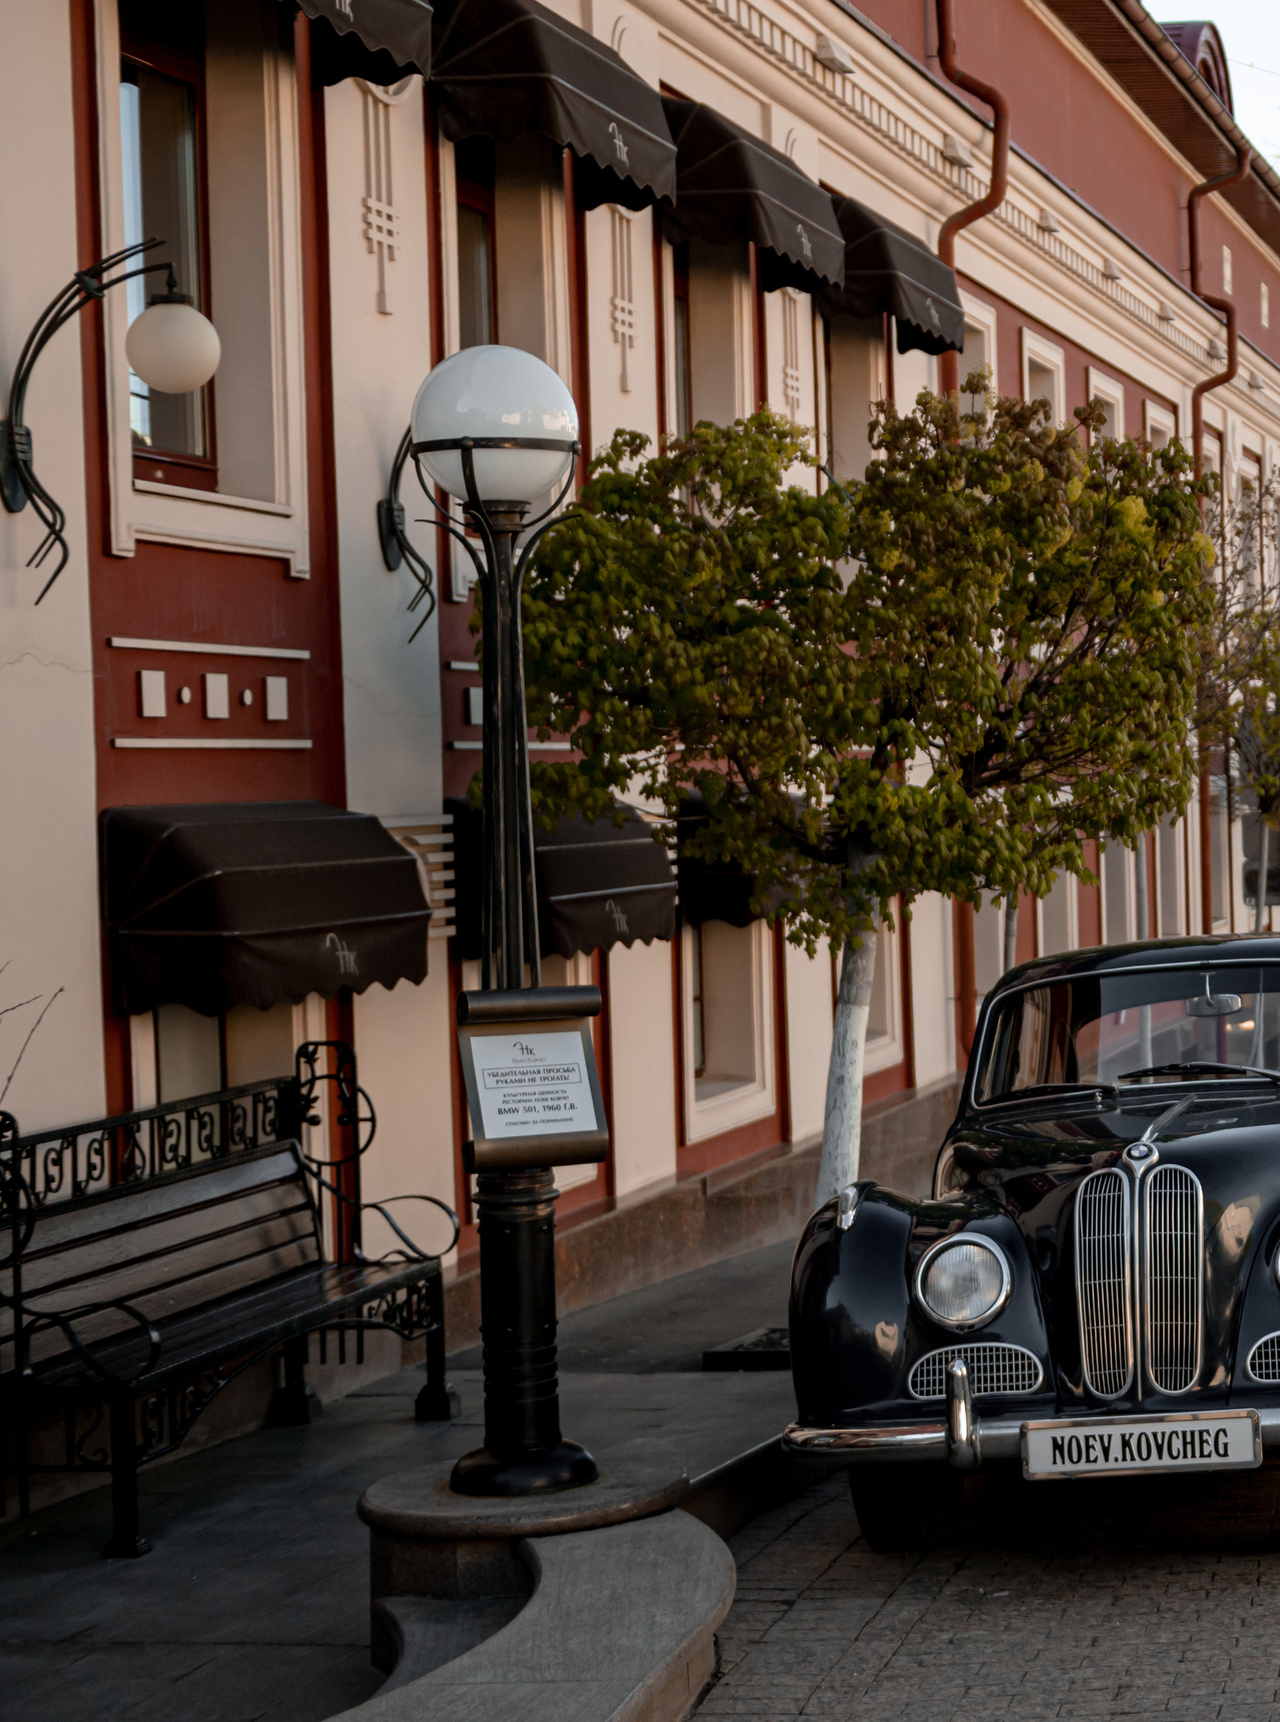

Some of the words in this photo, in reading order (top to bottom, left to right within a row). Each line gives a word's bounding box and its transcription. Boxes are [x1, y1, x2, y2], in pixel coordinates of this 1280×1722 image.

[487, 1069, 542, 1078] УБЕДИТЕЛЬНАЯ
[543, 1066, 576, 1075] ПРОСЬБА
[495, 1077, 526, 1085] РУКАМИ
[539, 1074, 570, 1082] ТРОГАТЬ!
[497, 1107, 520, 1115] BMW
[522, 1105, 540, 1113] 501,
[543, 1104, 562, 1112] 1960
[1051, 1427, 1230, 1465] NOEV.KOVCHEG
